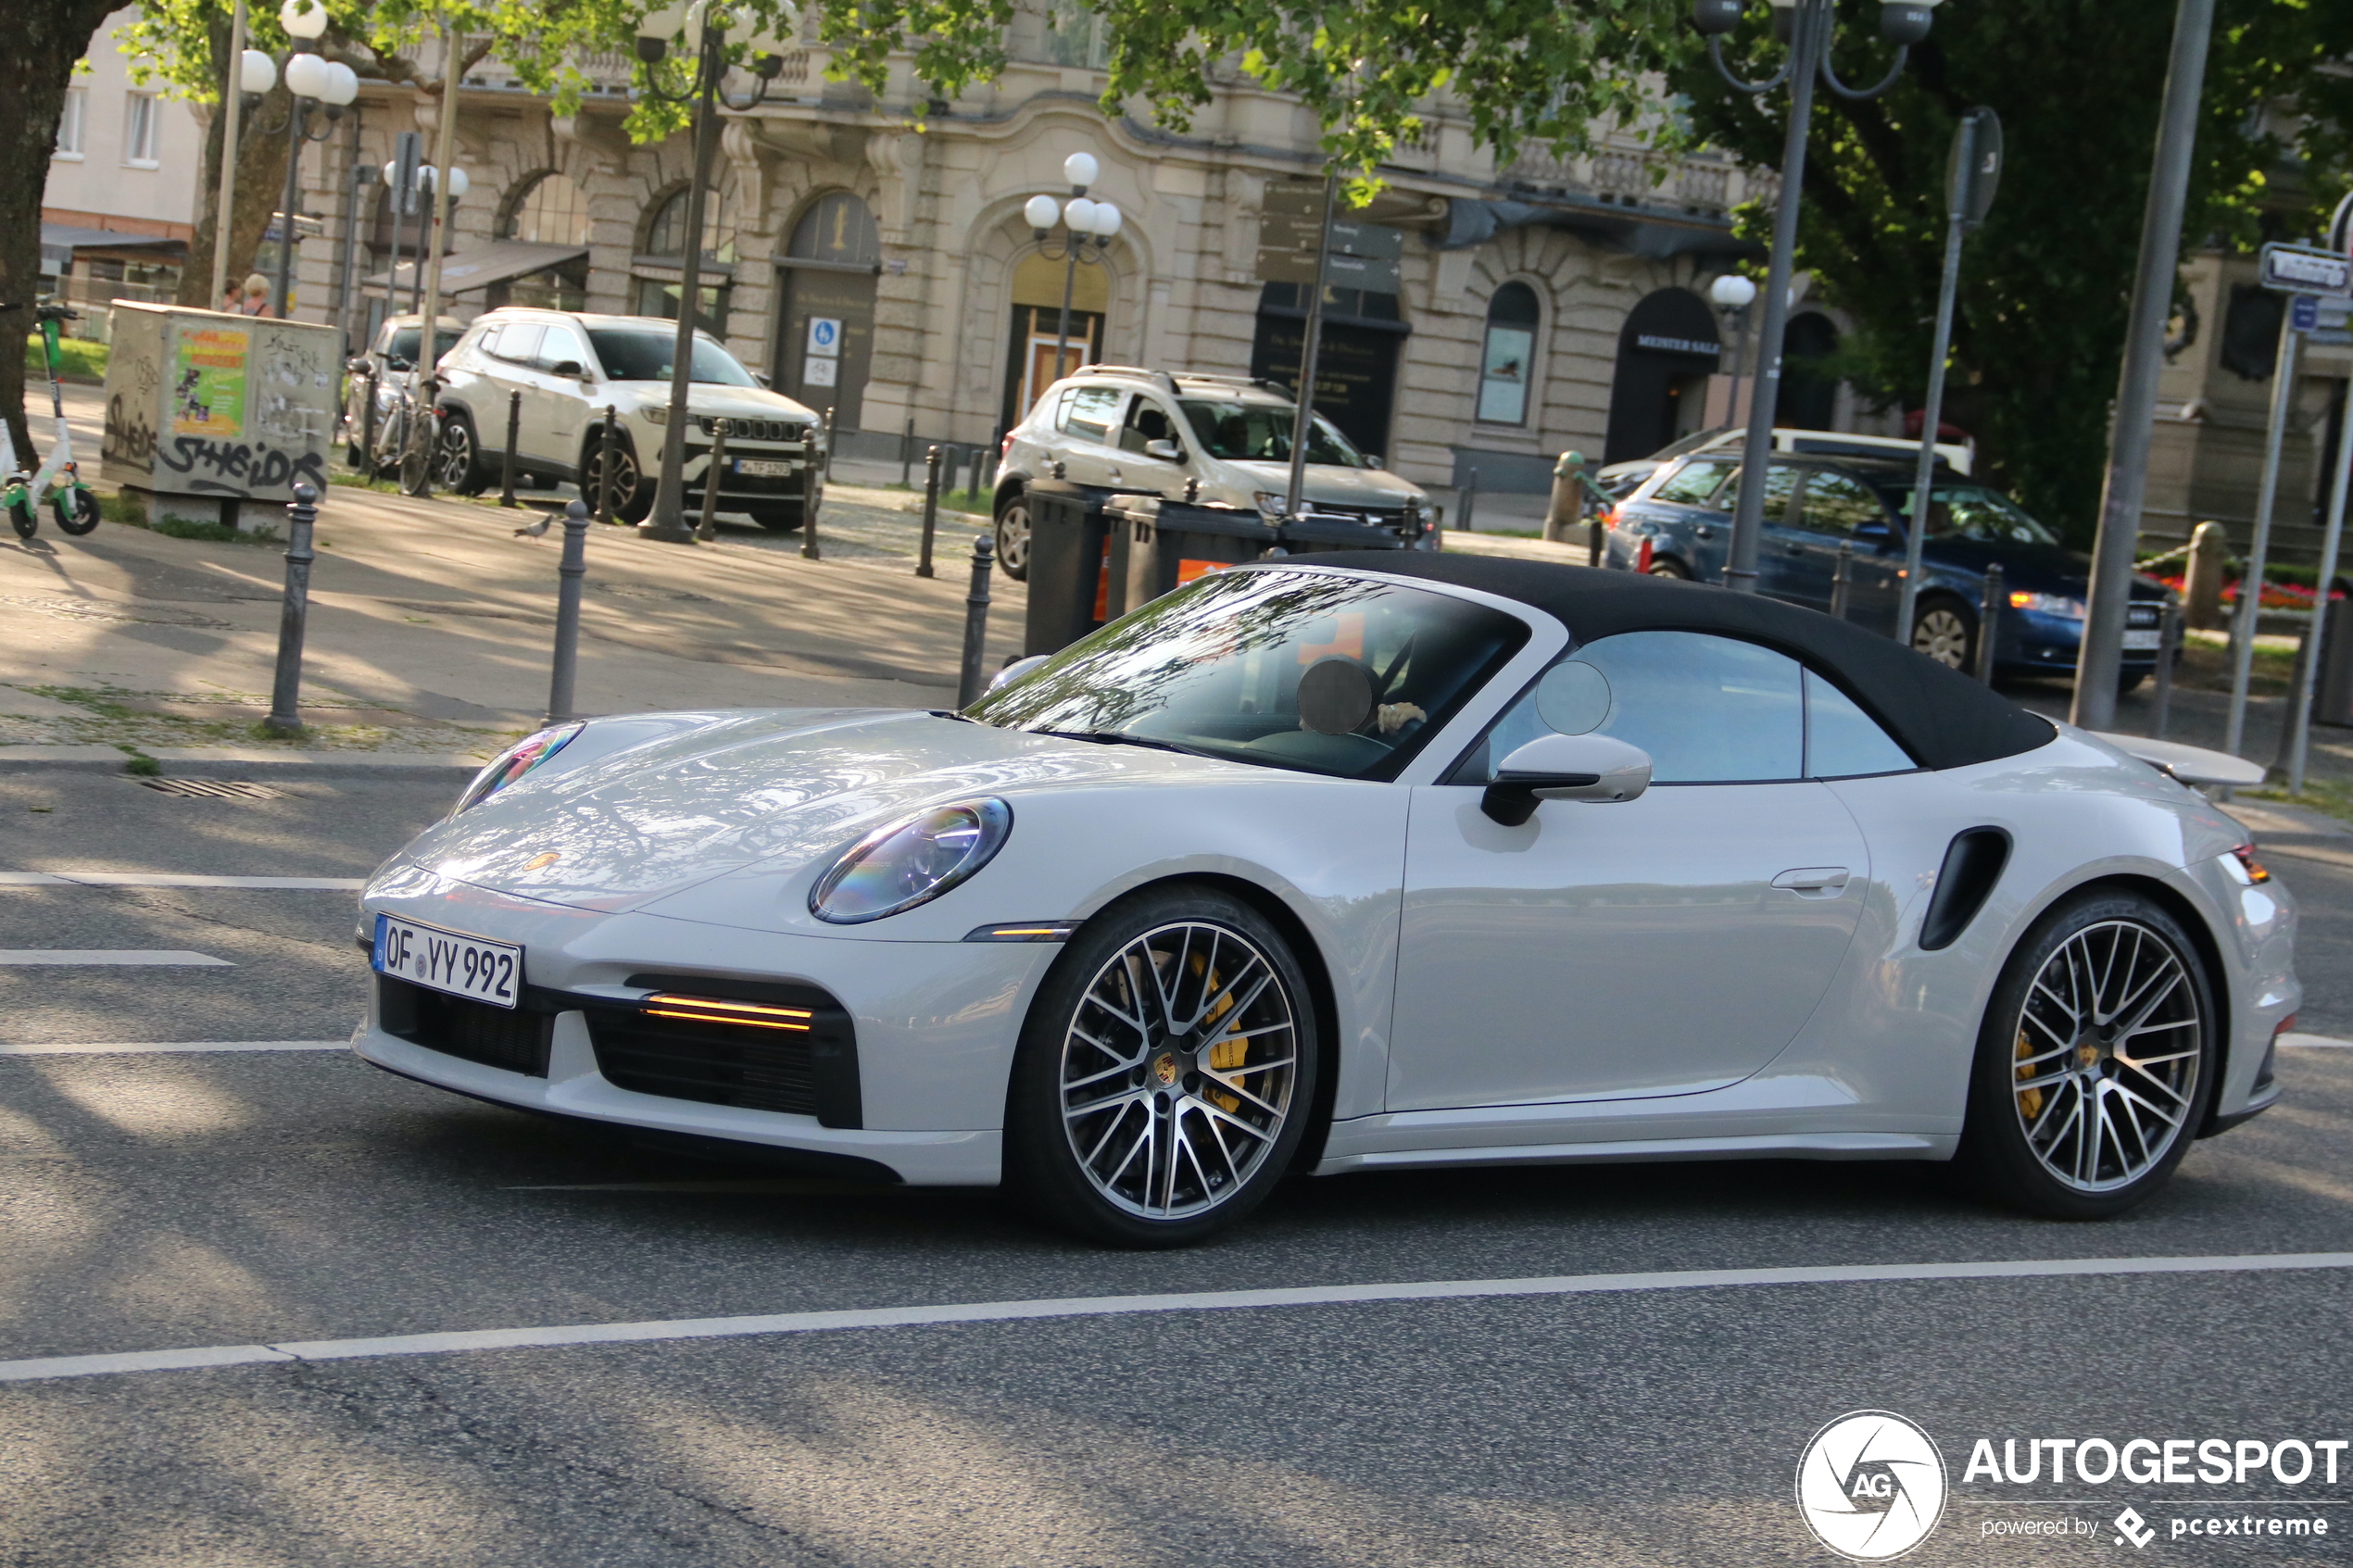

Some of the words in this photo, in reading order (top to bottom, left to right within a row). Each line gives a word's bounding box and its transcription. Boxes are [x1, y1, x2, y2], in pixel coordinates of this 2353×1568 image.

[377, 949, 382, 961] D
[387, 926, 413, 971] OF
[428, 936, 459, 985] YY
[464, 947, 513, 998] 992
